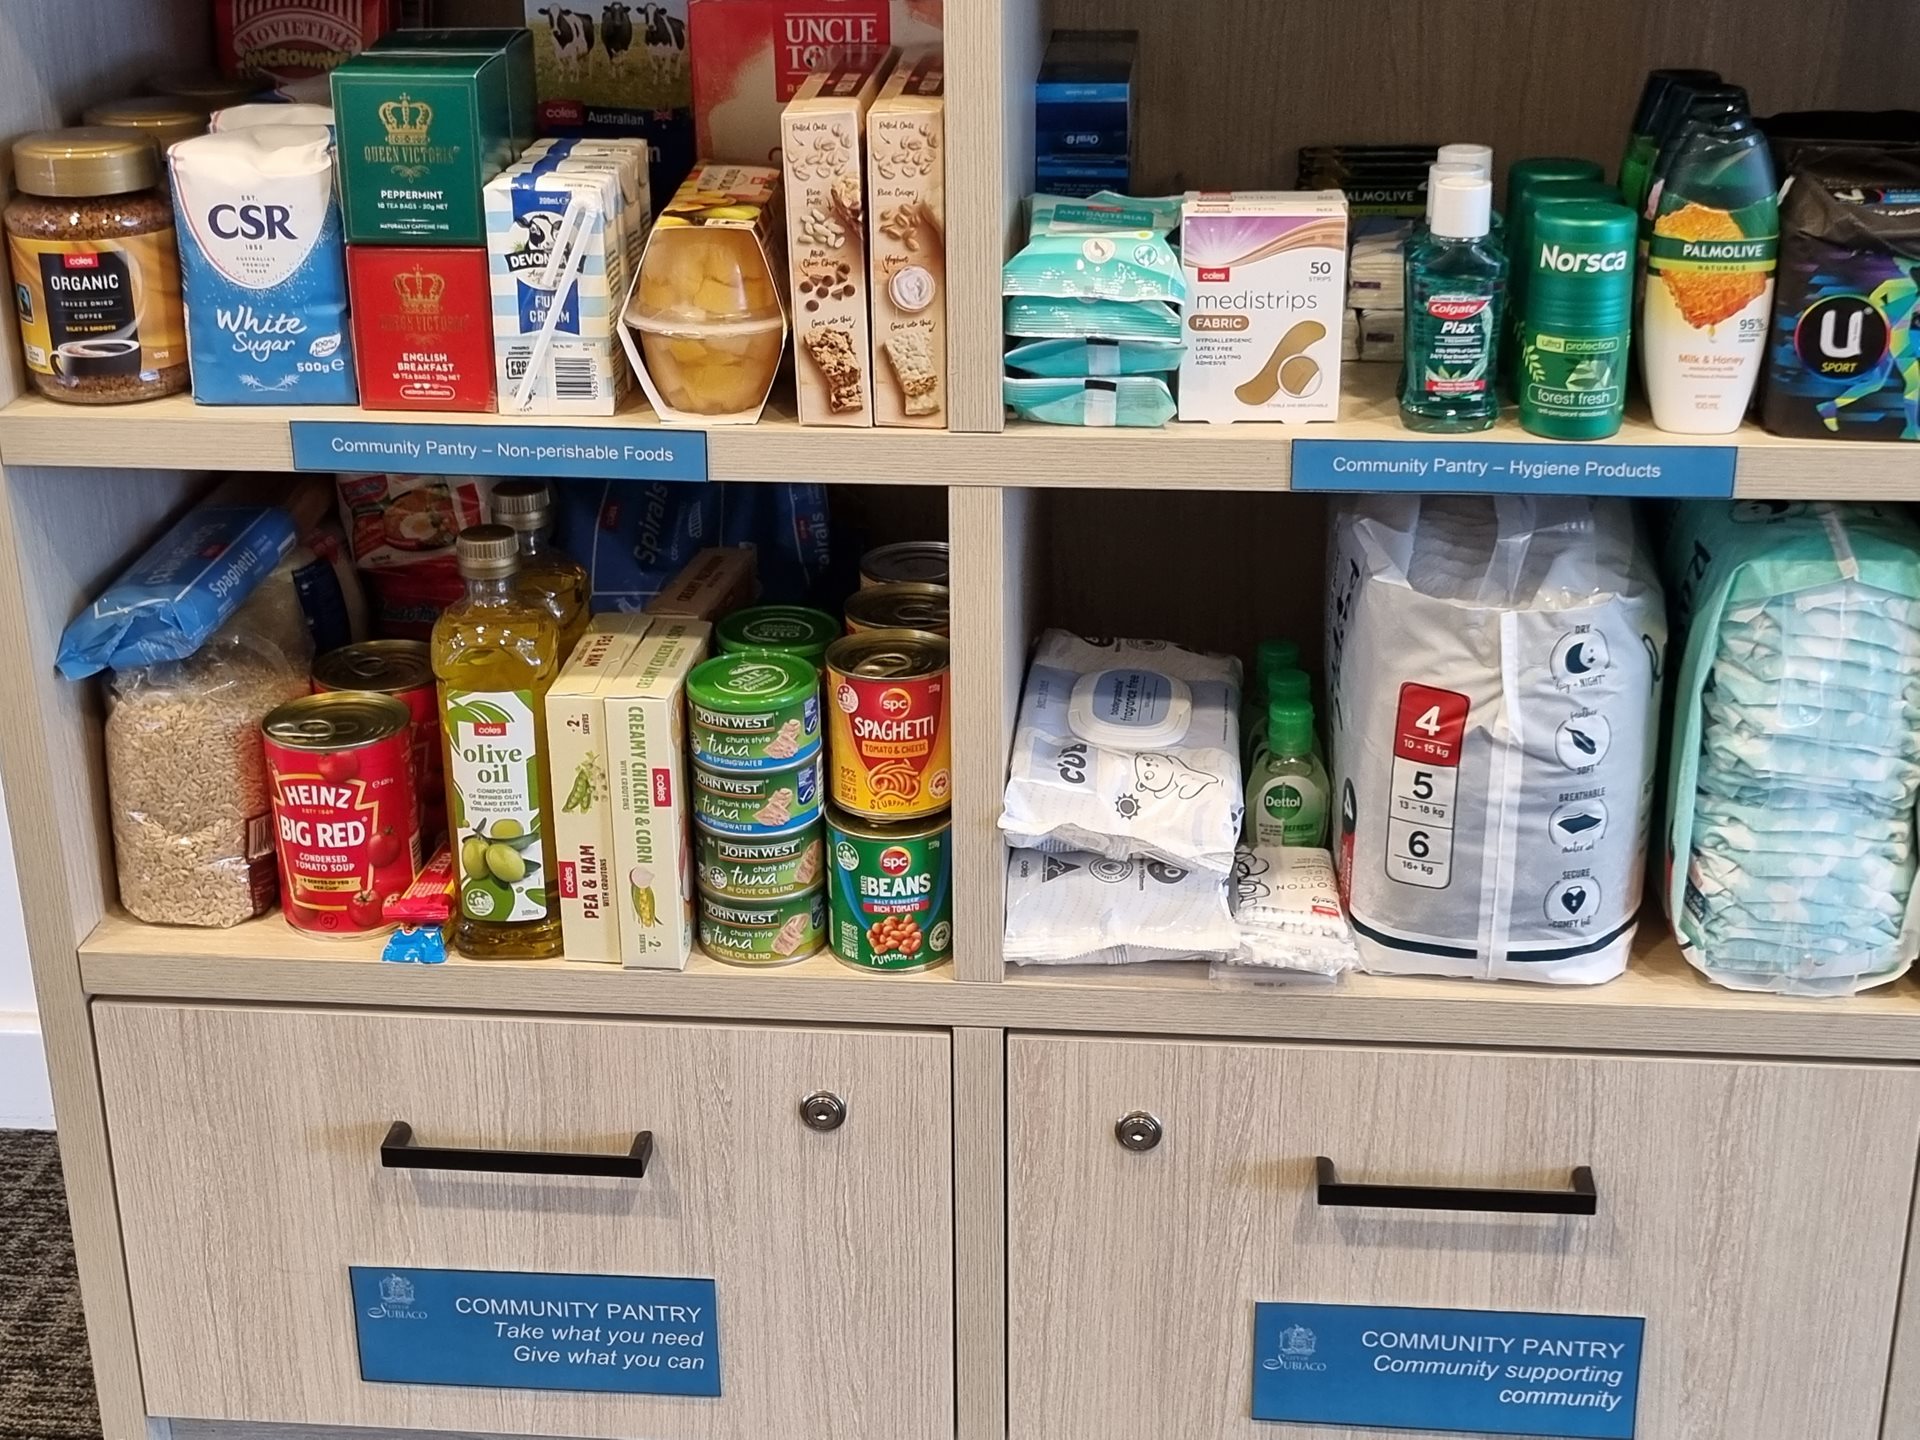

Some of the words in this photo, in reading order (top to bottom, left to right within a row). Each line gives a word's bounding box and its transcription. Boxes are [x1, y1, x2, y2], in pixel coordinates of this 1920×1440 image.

[239, 20, 357, 50] MOVIETIME
[785, 18, 878, 43] UNCLE
[545, 106, 578, 119] coles
[587, 111, 645, 126] Australian
[364, 146, 401, 164] QUEEN
[380, 190, 443, 200] PEPPERMINT
[1346, 191, 1415, 201] ALMOLIVE
[208, 204, 298, 240] CSR
[1539, 243, 1627, 273] Norsca
[1682, 244, 1765, 259] PALMOLIVE
[69, 256, 94, 266] coles
[1310, 261, 1331, 275] 50
[51, 274, 119, 291] ORGANIC
[1202, 271, 1226, 280] coles
[1196, 290, 1318, 311] medistrips
[1431, 303, 1478, 315] Colgate
[216, 304, 308, 335] White
[1195, 318, 1243, 329] FABRIC
[1441, 321, 1476, 334] Plax
[1739, 318, 1765, 330] 95%
[232, 332, 296, 362] Sugar
[402, 352, 448, 362] ENGLISH
[1678, 354, 1699, 364] Milk
[1702, 355, 1709, 364] &
[1713, 355, 1745, 366] Honey
[296, 362, 329, 373] 500g
[397, 362, 454, 373] BREAKFAST
[1821, 362, 1858, 373] SPORT
[1537, 388, 1575, 404] forest
[1578, 391, 1610, 405] fresh
[331, 438, 421, 458] Community
[426, 440, 478, 460] Pantry
[498, 442, 619, 461] Non-perishable
[624, 446, 674, 462] Foods
[1333, 456, 1428, 476] Community
[1433, 457, 1488, 477] Pantry
[1509, 459, 1580, 479] Hygiene
[1585, 460, 1661, 479] Products
[633, 481, 668, 565] Spirals
[208, 547, 258, 598] Spaghetti
[1575, 624, 1591, 634] DRY
[883, 699, 907, 712] spc
[699, 711, 730, 727] JOHN
[731, 717, 769, 729] WEST
[854, 715, 934, 741] SPAGHETTI
[1415, 705, 1440, 736] 4
[478, 726, 502, 735] coles
[628, 706, 647, 759] CREAMY
[707, 733, 750, 757] tuna
[725, 735, 750, 744] chunk
[751, 736, 771, 745] style
[864, 743, 893, 754] TOMATO
[901, 742, 927, 753] CHEESE
[1403, 739, 1414, 750] 10
[1424, 743, 1435, 754] 15
[1436, 743, 1449, 758] kg
[463, 744, 522, 764] olive
[477, 764, 510, 783] oil
[1576, 764, 1595, 775] SOFT
[631, 761, 650, 815] CHICKEN
[656, 774, 667, 802] coles
[696, 770, 721, 790] JOHN
[723, 781, 760, 794] WEST
[1412, 770, 1433, 800] 5
[284, 785, 352, 809] HEINZ
[1265, 796, 1301, 808] Dettol
[1559, 787, 1606, 802] BREATHABLE
[702, 795, 740, 821] tuna
[718, 799, 740, 807] chunk
[741, 801, 760, 809] style
[1399, 800, 1409, 810] 13
[1419, 804, 1430, 815] 18
[1432, 806, 1445, 818] kg
[634, 816, 650, 826] &
[280, 815, 312, 847] BIG
[316, 821, 366, 848] RED
[635, 829, 653, 864] CORN
[722, 845, 760, 858] JOHN
[761, 844, 797, 857] WEST
[1408, 830, 1430, 858] 6
[295, 860, 328, 872] TOMATO
[330, 863, 355, 873] SOUP
[299, 852, 348, 863] CONDENSED
[579, 845, 596, 874] HAM
[883, 856, 907, 870] spc
[600, 858, 610, 892] CROUTONS
[730, 865, 777, 885] tuna
[752, 864, 777, 873] chunk
[779, 862, 796, 872] style
[1402, 860, 1418, 871] 16+
[1421, 862, 1434, 875] kg
[1562, 868, 1591, 880] SECURE
[563, 865, 574, 893] coles
[581, 881, 598, 893] &
[868, 873, 932, 897] BEANS
[727, 885, 734, 893] IN
[736, 887, 756, 895] OLIVE
[758, 887, 770, 895] OIL
[772, 884, 795, 894] BLEND
[583, 894, 600, 919] PEA
[602, 892, 610, 907] WITH
[873, 905, 891, 913] RICH
[892, 903, 920, 913] TOMATO
[707, 905, 734, 921] JOHN
[736, 912, 775, 924] WEST
[713, 925, 753, 950] tuna
[730, 929, 752, 938] chunk
[754, 930, 773, 939] style
[716, 946, 734, 957] OLIVE
[748, 952, 771, 960] BLEND
[367, 1302, 428, 1320] SUBIACO
[455, 1297, 600, 1319] COMMUNITY
[607, 1303, 702, 1324] PANTRY
[494, 1321, 544, 1340] Take
[552, 1324, 601, 1343] what
[607, 1330, 645, 1347] you
[651, 1331, 704, 1347] need
[1361, 1330, 1516, 1355] COMMUNITY
[1522, 1338, 1625, 1360] PANTRY
[513, 1346, 560, 1364] Give
[568, 1348, 617, 1366] what
[623, 1353, 661, 1370] you
[667, 1356, 705, 1370] can
[1262, 1353, 1327, 1372] SUBIACO
[1373, 1355, 1500, 1382] Community
[1504, 1361, 1624, 1388] supporting
[1499, 1388, 1622, 1412] community
